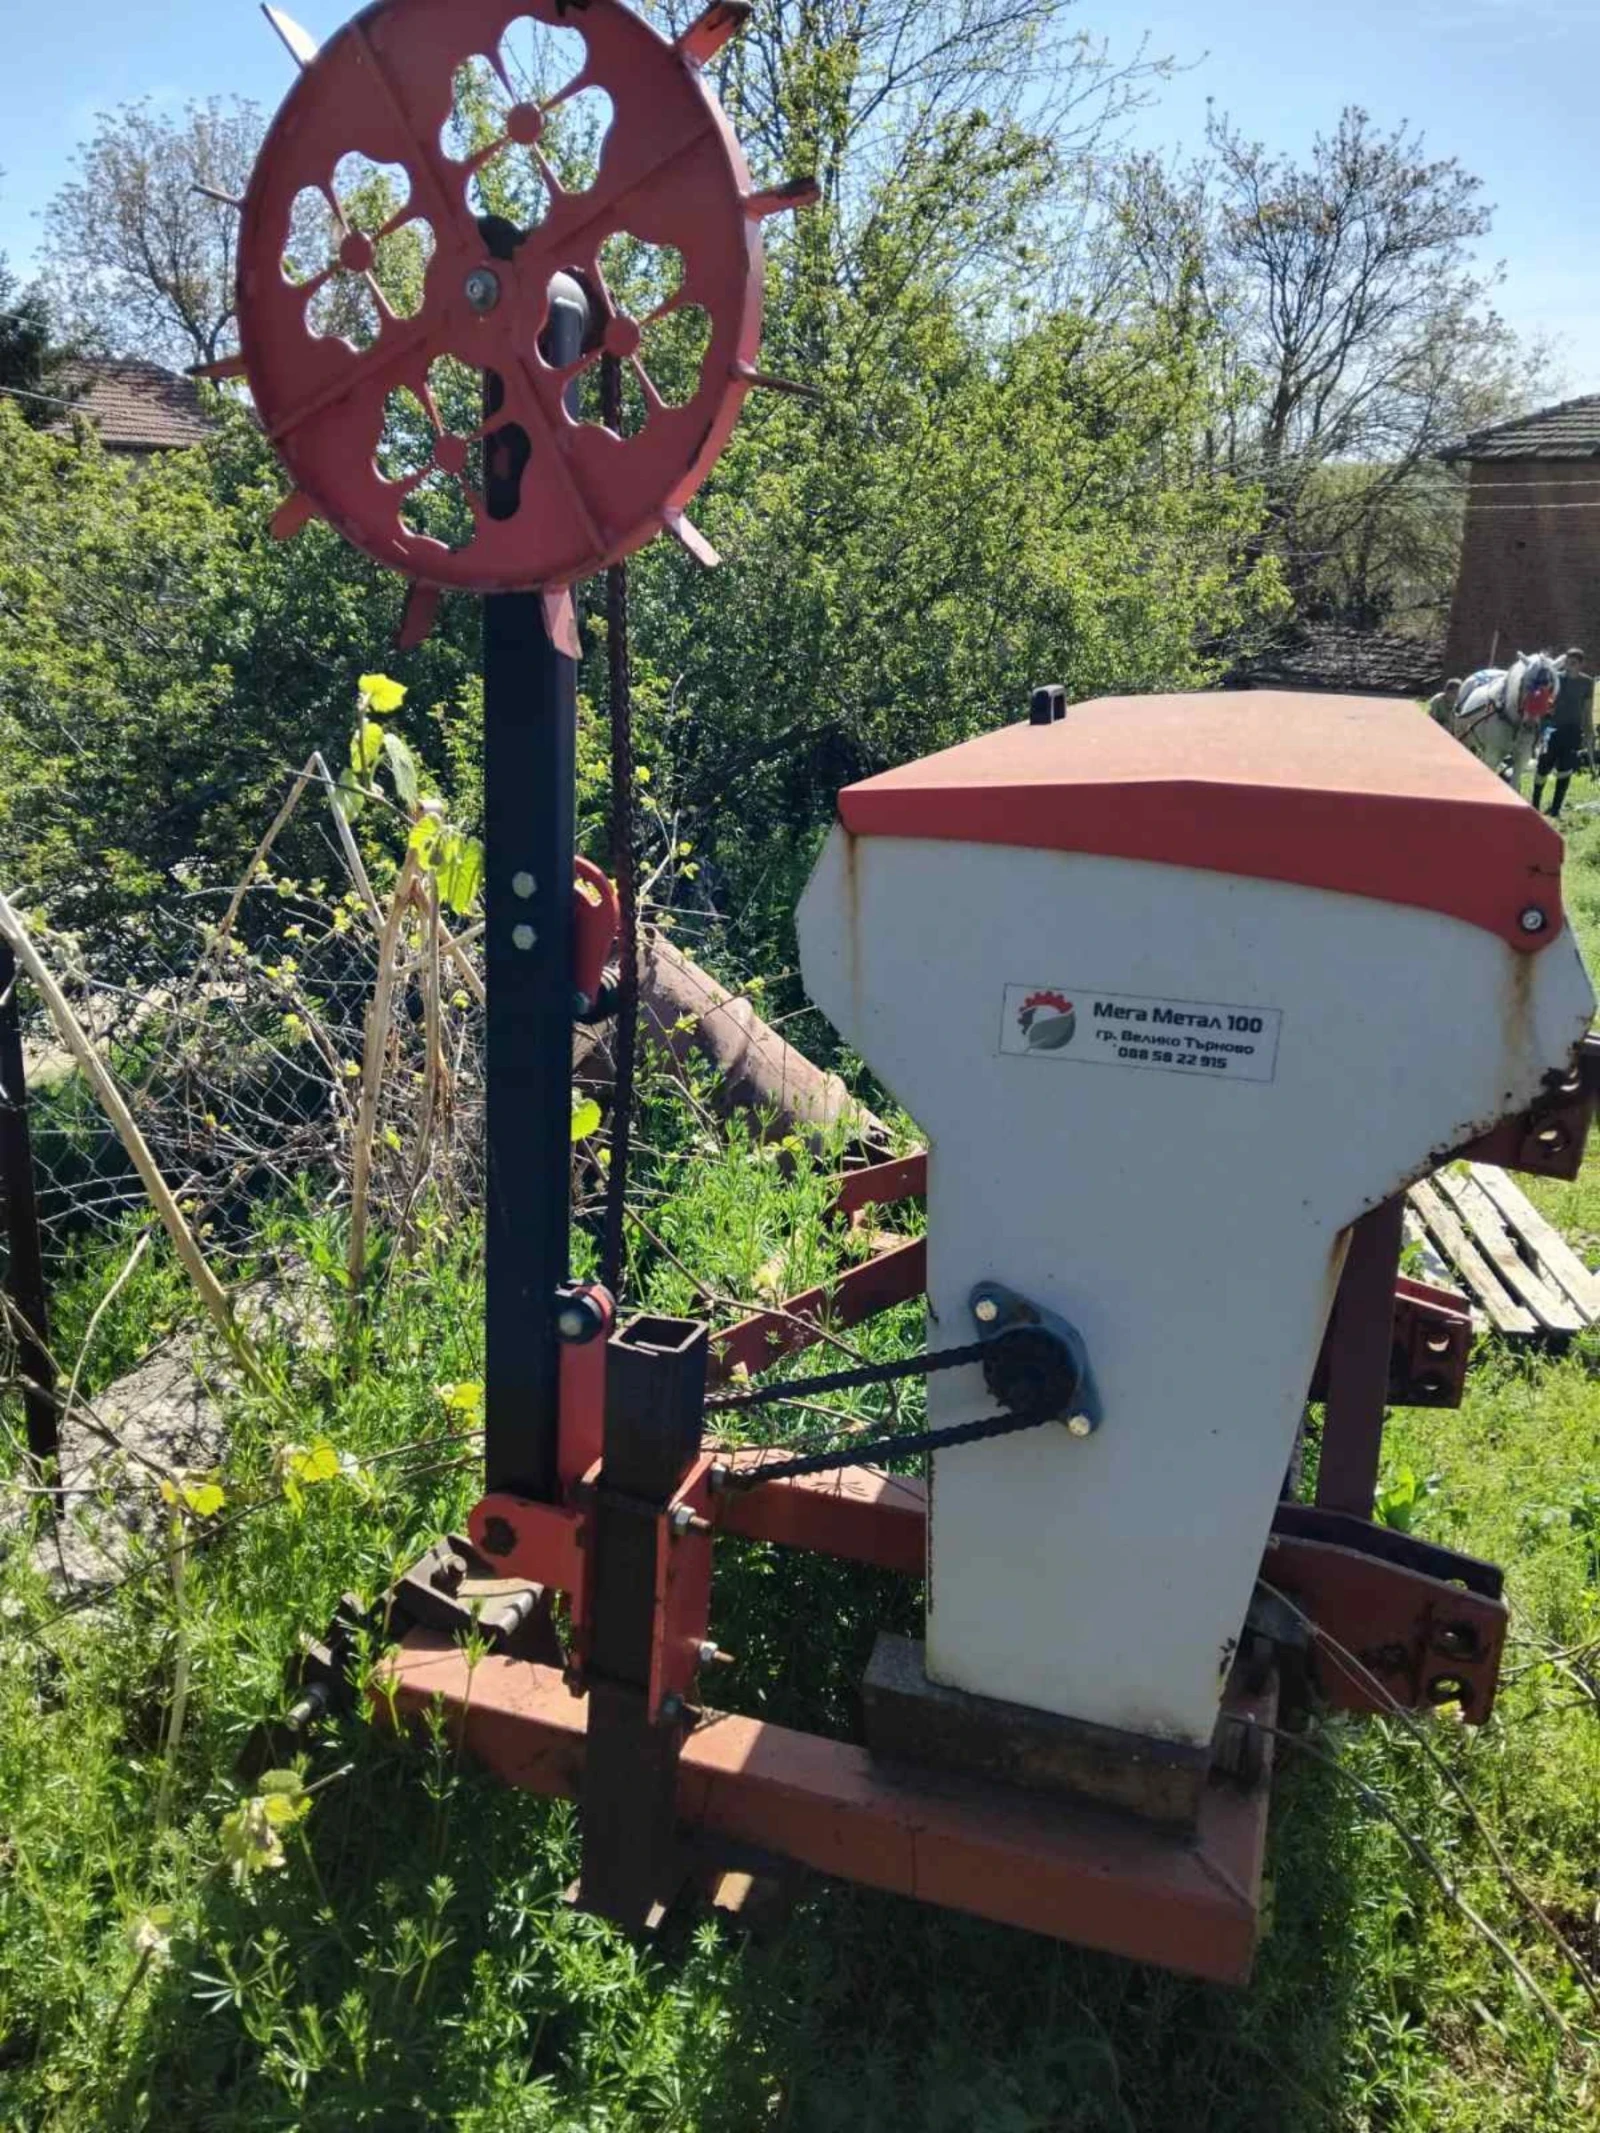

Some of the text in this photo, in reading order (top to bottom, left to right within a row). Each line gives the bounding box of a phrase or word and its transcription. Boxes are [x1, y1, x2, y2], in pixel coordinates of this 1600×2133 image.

[1093, 1001, 1263, 1034] Мега Метал 100
[1096, 1029, 1255, 1055] гр. Велико Търново
[1118, 1046, 1228, 1069] 088 58 22 915
